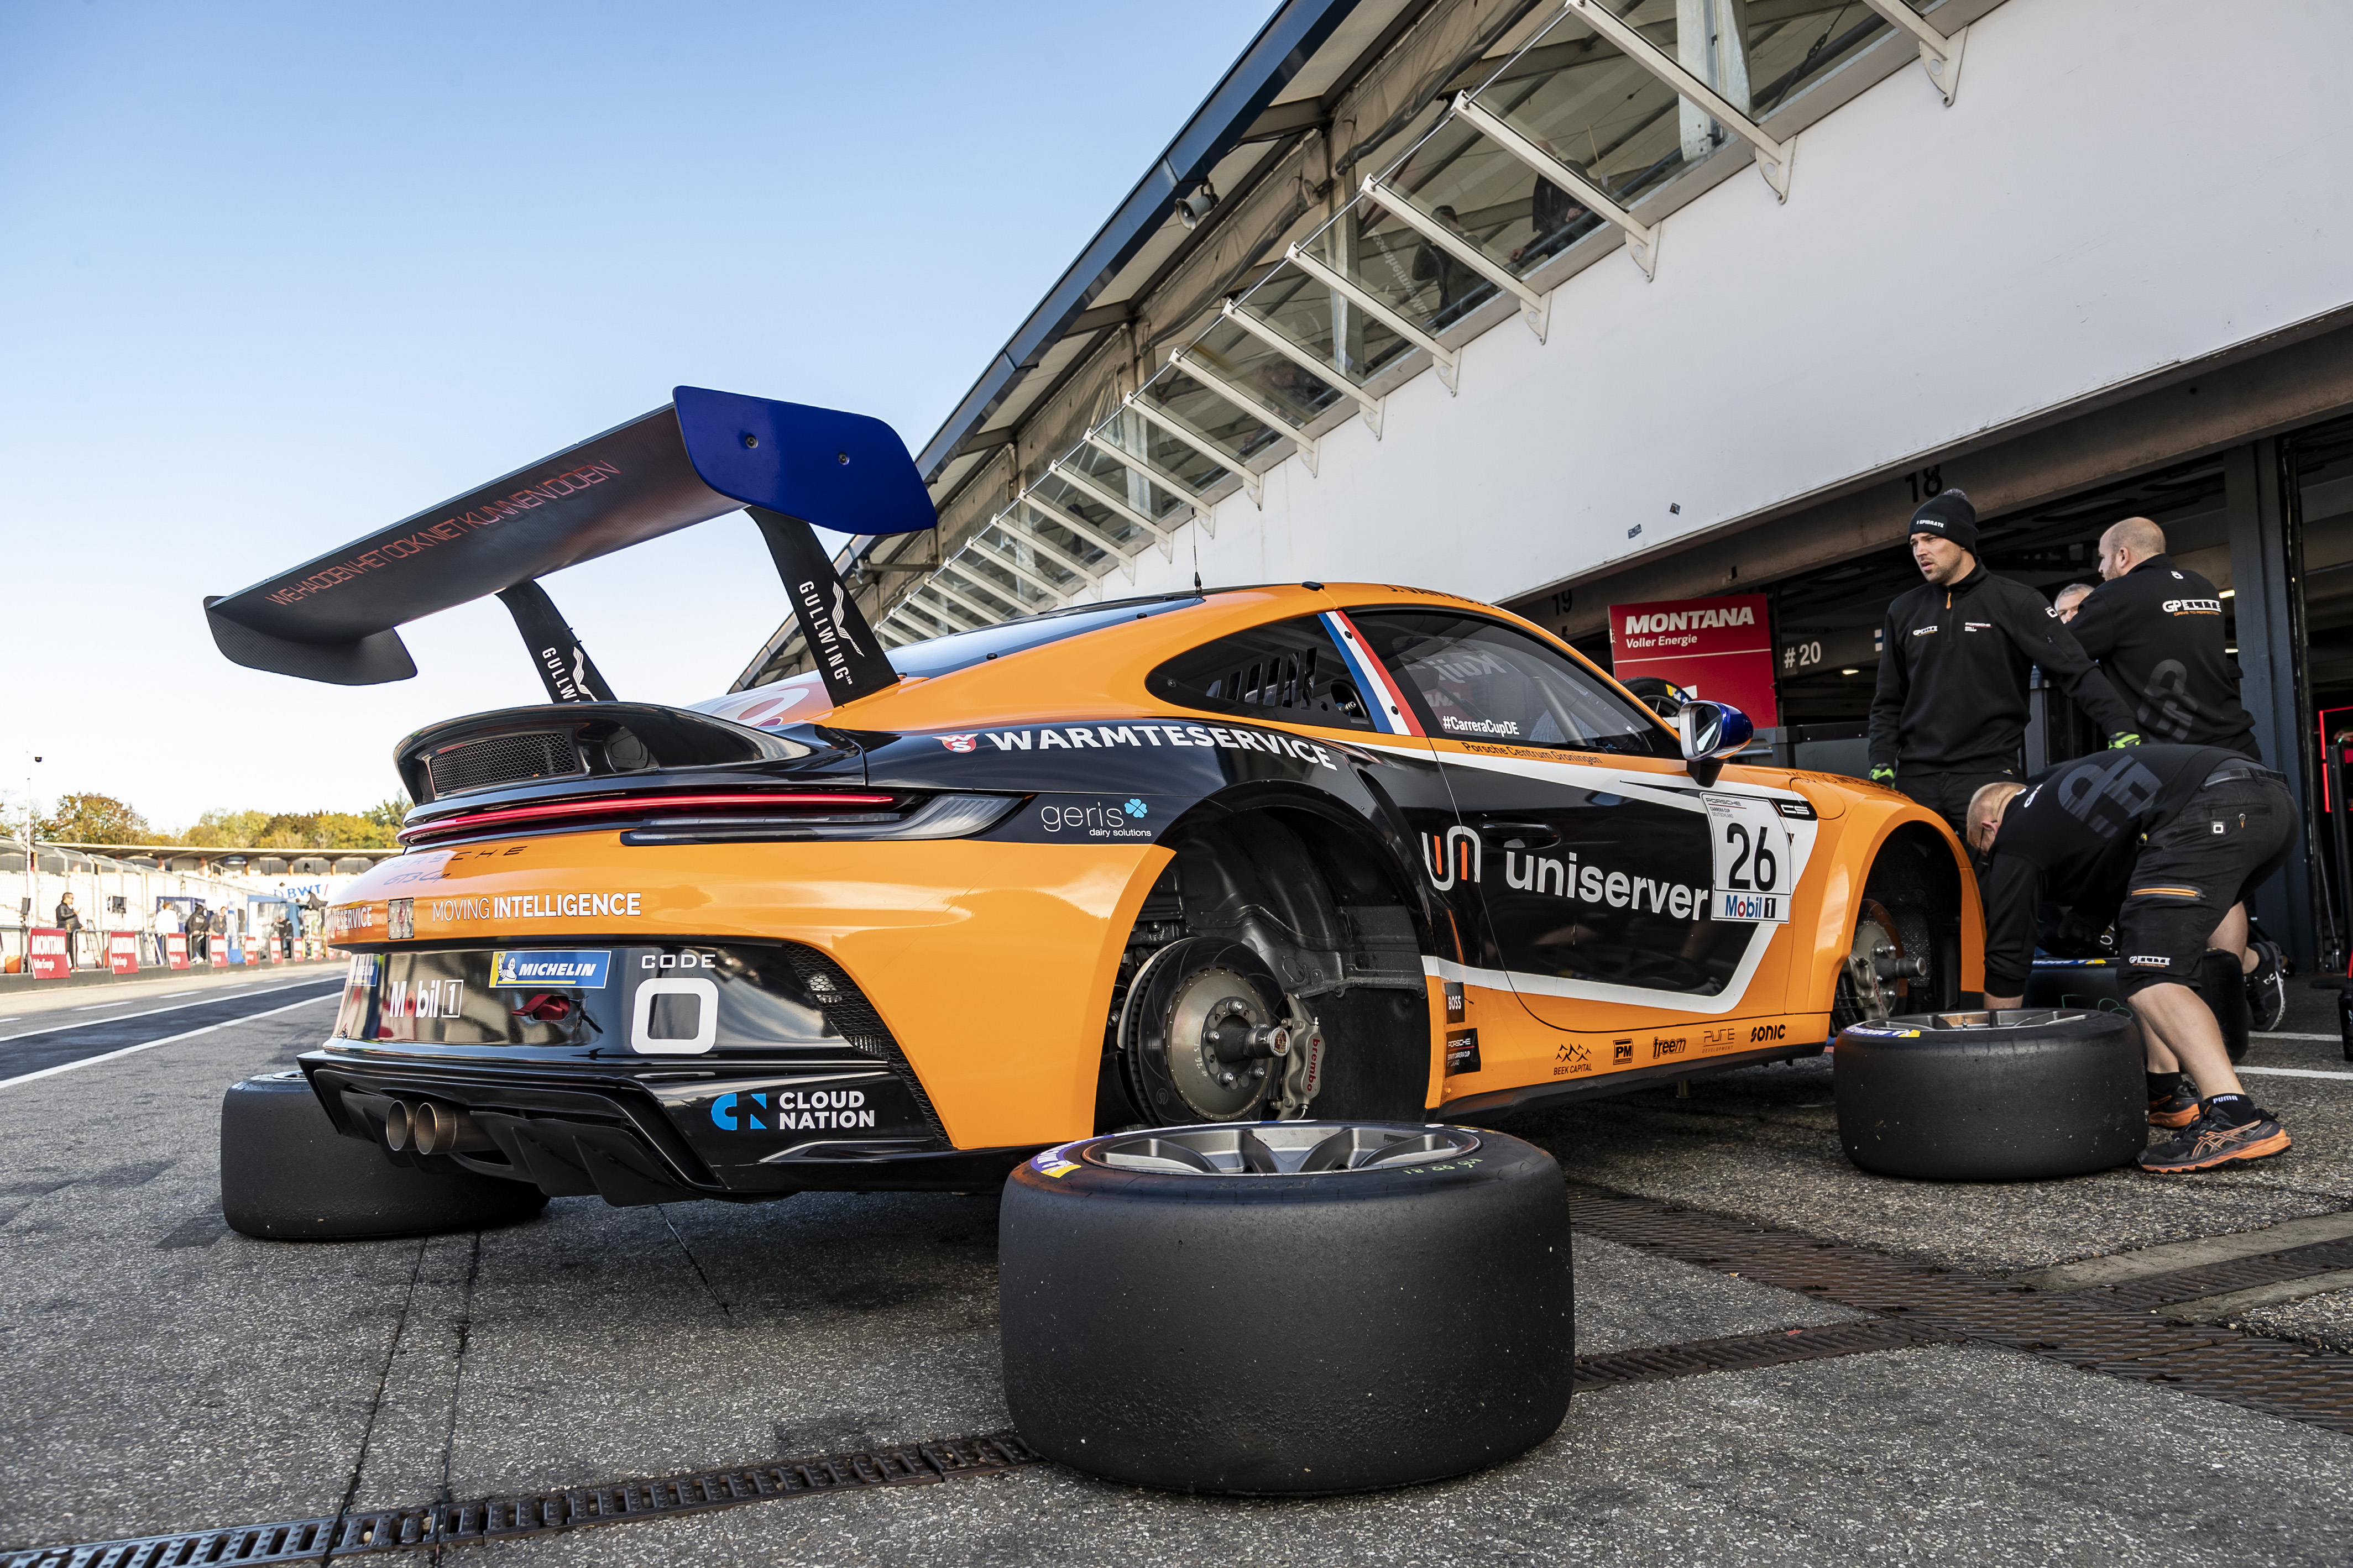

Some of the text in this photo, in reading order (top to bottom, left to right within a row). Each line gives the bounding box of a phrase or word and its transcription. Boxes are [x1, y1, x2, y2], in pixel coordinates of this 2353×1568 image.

[1905, 465, 1942, 503] 18
[265, 460, 622, 606] WE HADDEN HET OOK NIET KUNNEN DOEN
[1552, 589, 1572, 616] 19
[799, 581, 849, 680] GULLWING
[1625, 607, 1755, 634] MONTANA
[1626, 634, 1698, 648] Voller Energie
[542, 647, 580, 702] GULLW
[1442, 715, 1519, 737] #CarreraCupDE
[985, 725, 1338, 770] WARMTESERVICE
[1461, 742, 1603, 765] Porsche Centrum Groningen
[1706, 798, 1742, 806] PORSCHE
[1040, 802, 1125, 832] geris
[1089, 828, 1152, 837] dairy solutions
[1727, 822, 1776, 892] 26
[384, 869, 451, 885] GT3 Cup
[1506, 851, 1708, 921] uniserver
[432, 892, 641, 922] MOVING INTELLIGENCE
[1725, 894, 1763, 918] Mobil
[32, 935, 66, 955] MONTANA
[518, 963, 597, 976] MICHELIN
[641, 954, 715, 969] CODE
[389, 980, 441, 1018] Mobil
[1448, 995, 1462, 1010] BOSS
[1448, 1038, 1471, 1048] PORSCHE
[1615, 1045, 1632, 1058] PM
[1653, 1037, 1686, 1059] freem
[1702, 1045, 1734, 1053] DEVELOPMENT
[1307, 1039, 1320, 1092] brembo
[1554, 1063, 1592, 1076] BEEK CAPITAL
[779, 1091, 865, 1109] CLOUD
[2213, 1093, 2239, 1104] PUMA
[780, 1110, 875, 1130] NATION
